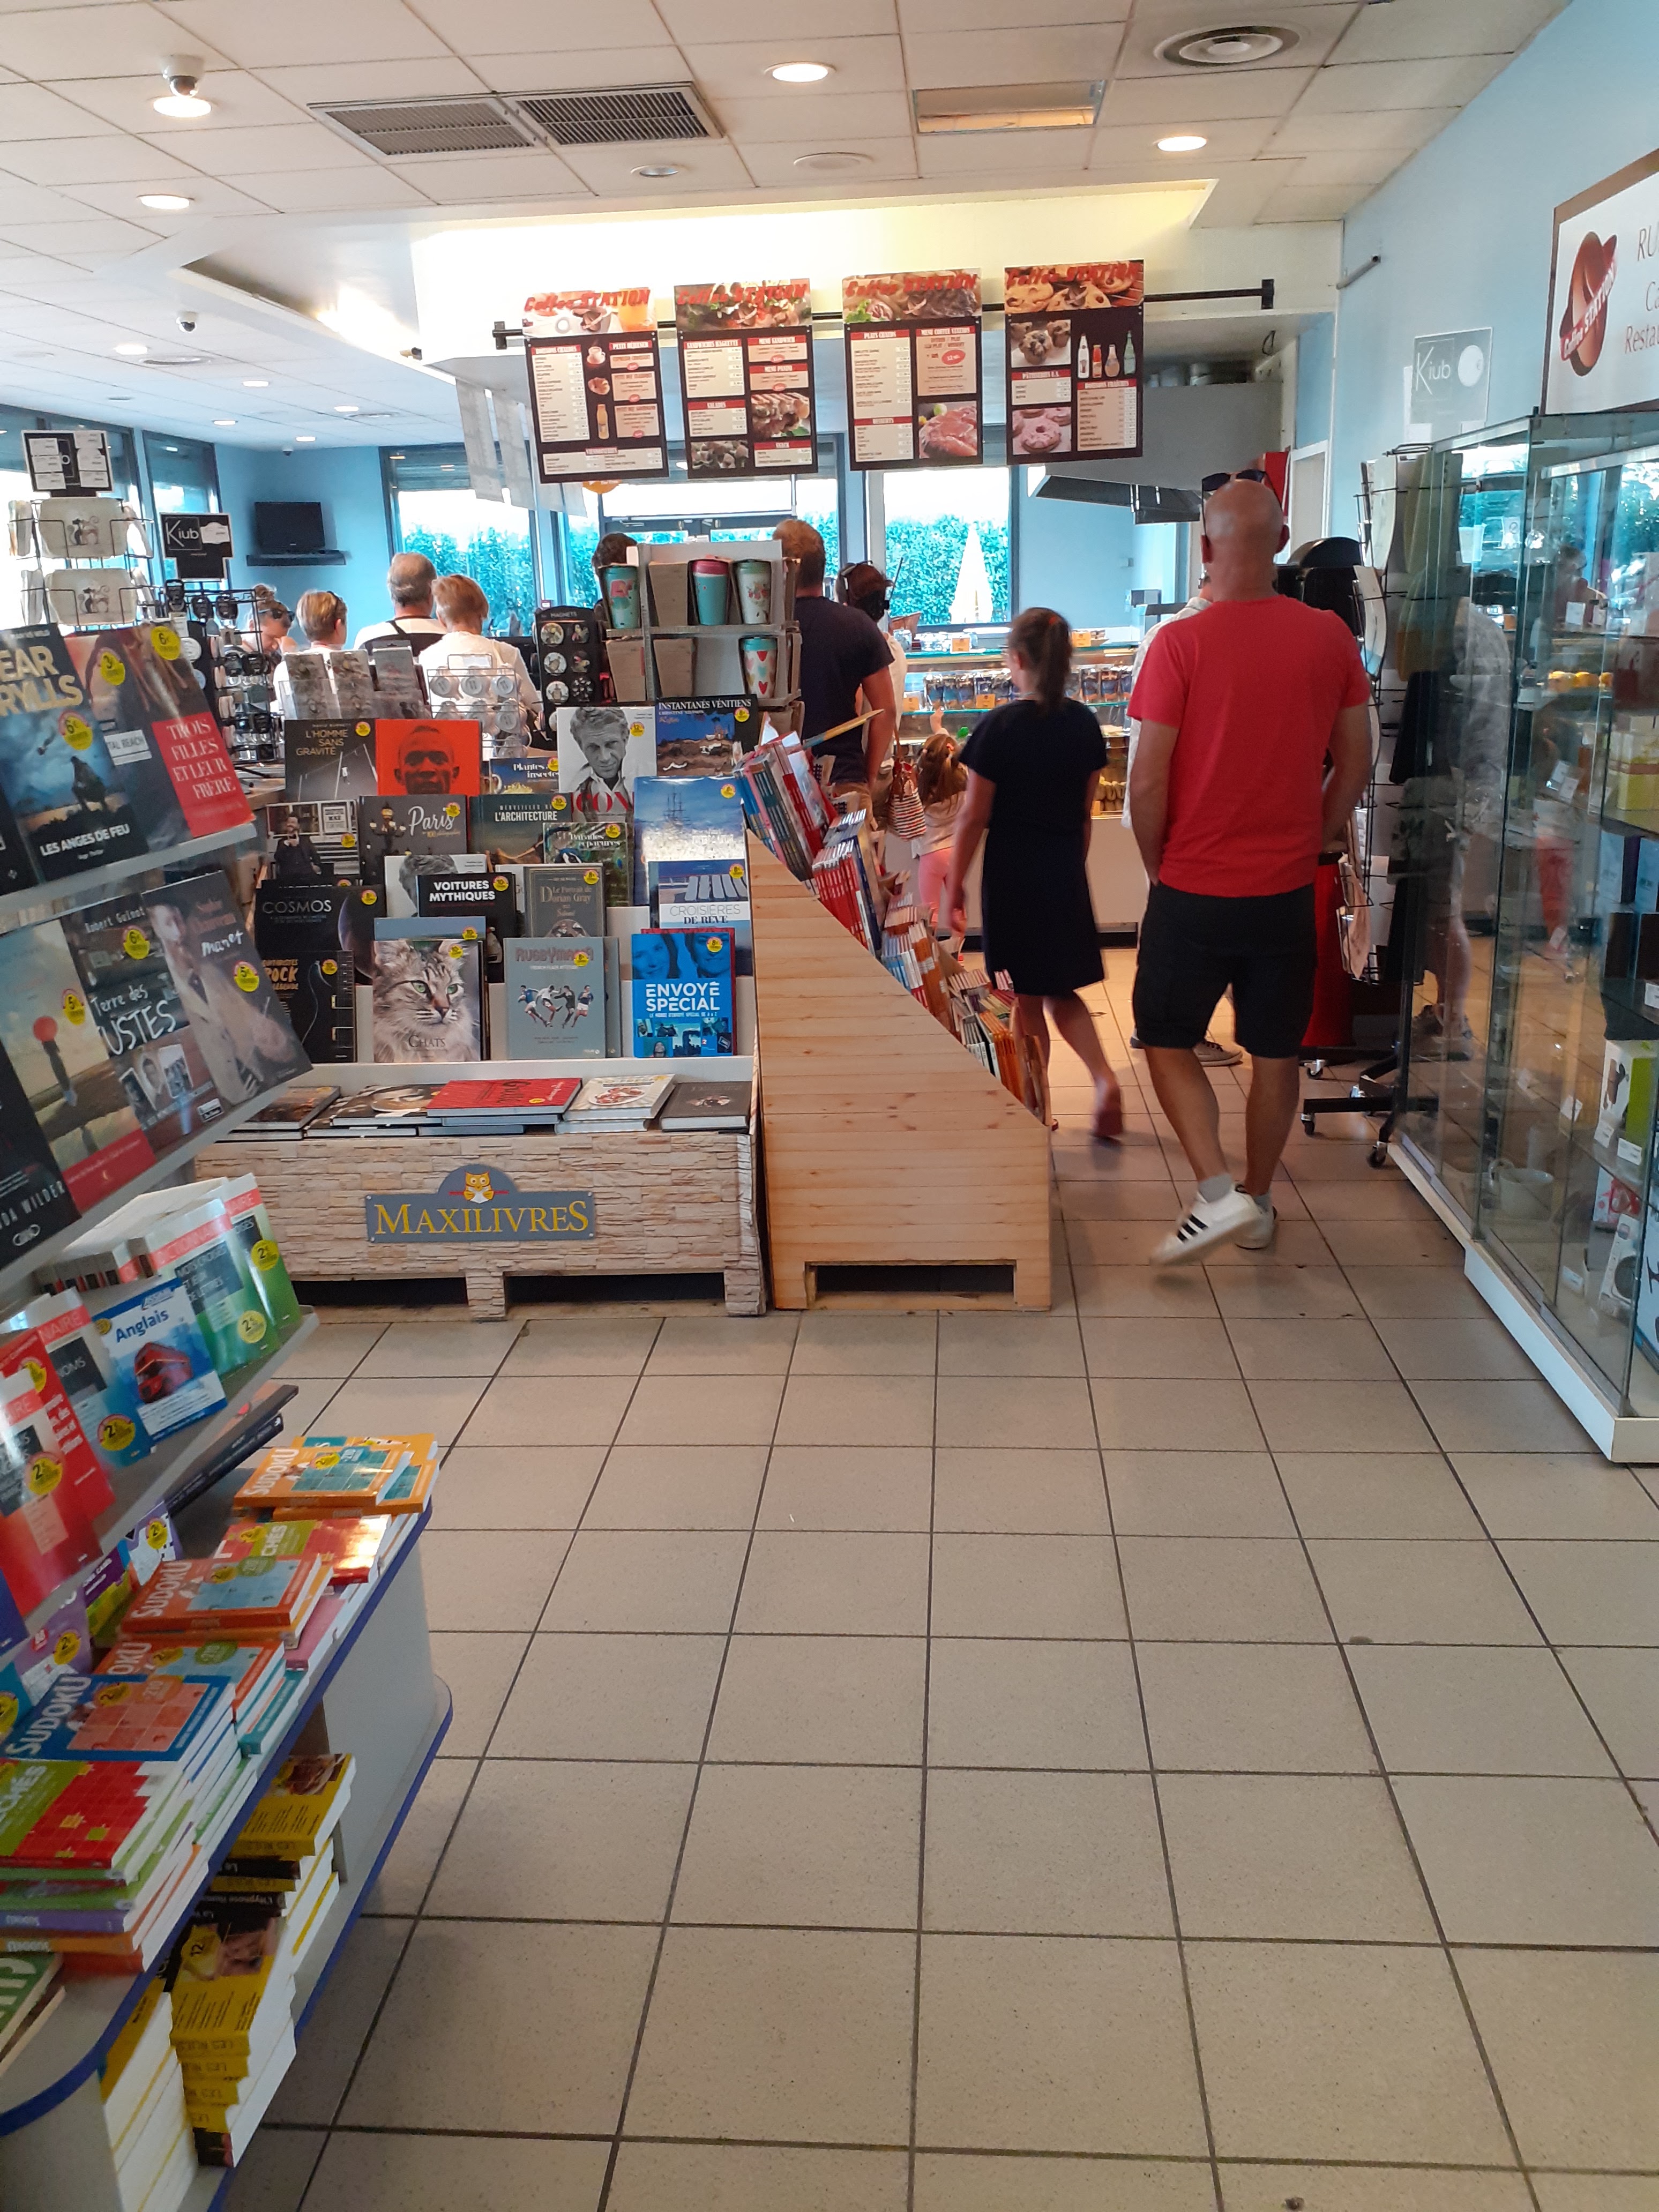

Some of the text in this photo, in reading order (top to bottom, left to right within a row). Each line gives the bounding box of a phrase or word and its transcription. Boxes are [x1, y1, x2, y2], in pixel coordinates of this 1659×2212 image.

[1415, 346, 1451, 395] Kiub
[165, 520, 200, 547] Kiub
[658, 698, 751, 711] INSTANTANÉS VÉNITIENS
[166, 719, 211, 740] TROIS
[171, 738, 219, 761] FILLES
[318, 738, 345, 746] SANS
[189, 757, 228, 780] LEUR
[408, 806, 455, 836] Paris
[495, 811, 558, 822] L'ARCHITECTURE
[40, 824, 130, 856] LES ANGES DE FEU
[429, 891, 496, 902] MYTHIQUES
[434, 880, 490, 891] VOITURES
[263, 900, 332, 913] COSMOS
[683, 916, 699, 925] DE
[90, 984, 148, 1017] Terre des
[646, 981, 720, 997] ENVOYÉ
[646, 997, 720, 1012] SPÉCIAL
[375, 1200, 589, 1235] MAXILIVRES
[116, 1309, 169, 1343] Anglais
[130, 1560, 193, 1618] SUDOKU
[5, 1674, 92, 1755] SUDOKU
